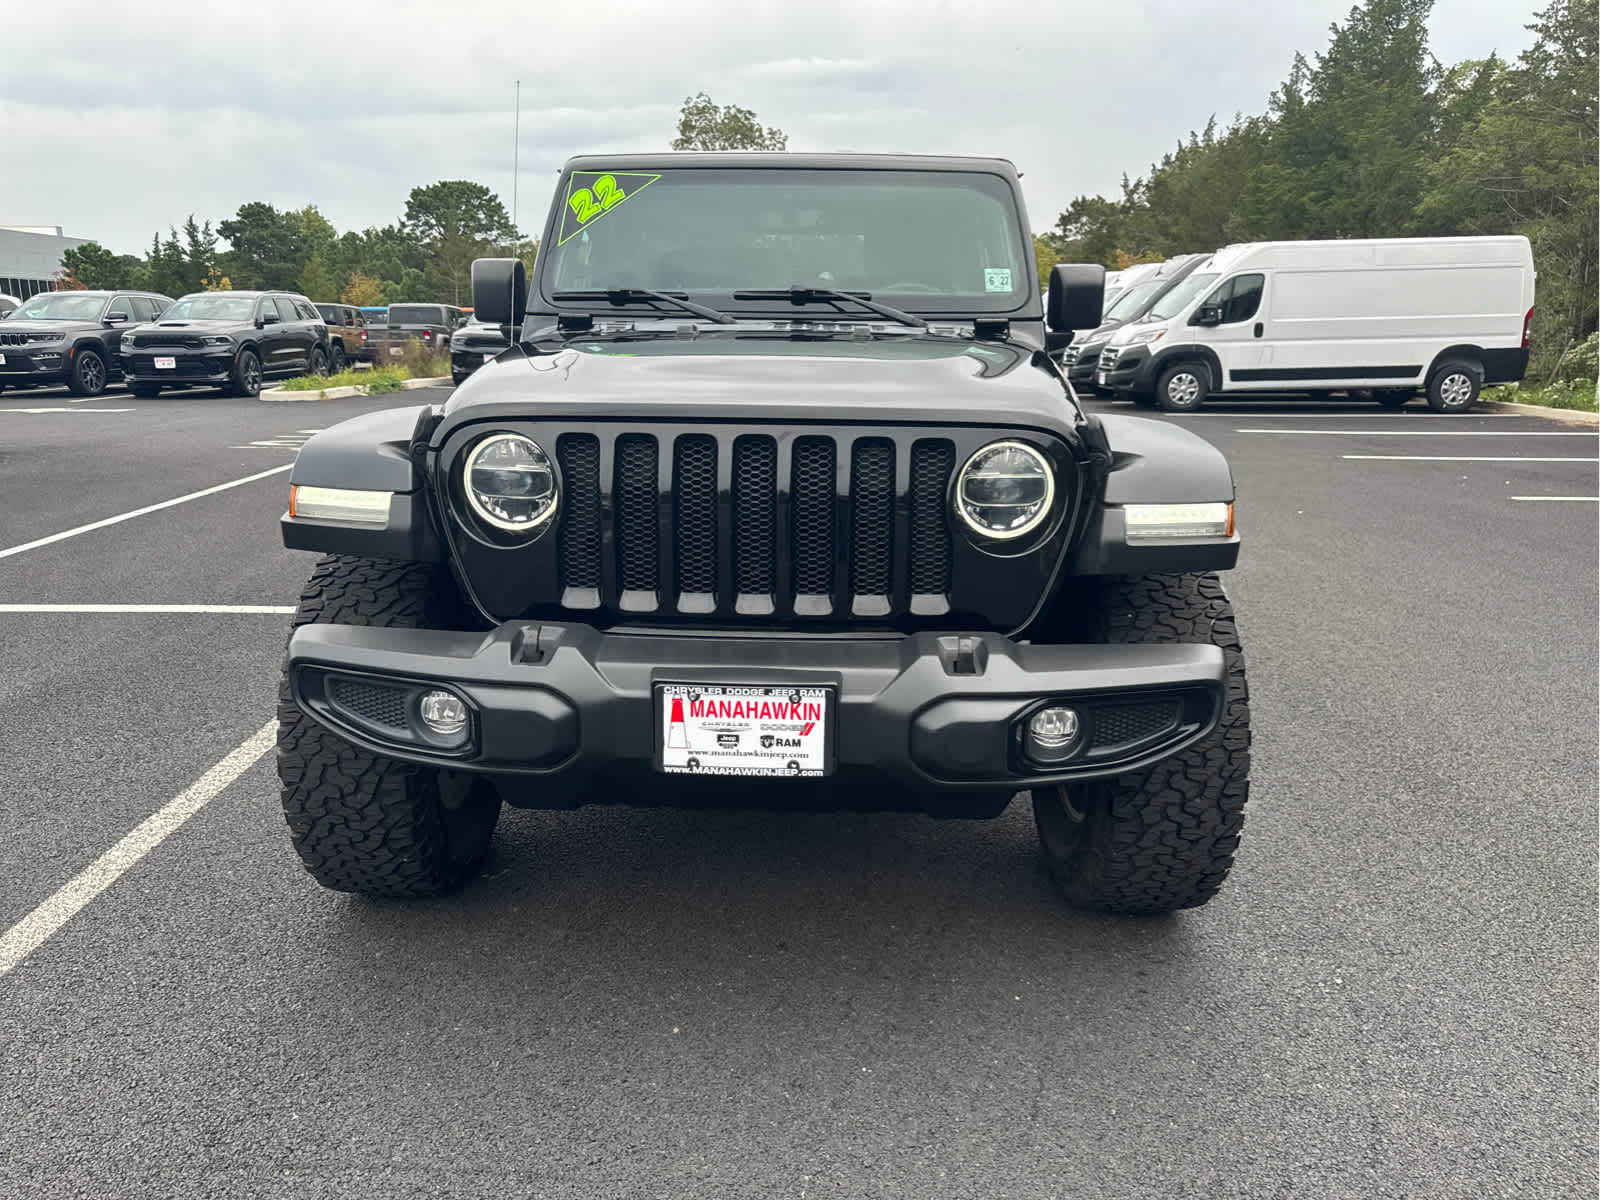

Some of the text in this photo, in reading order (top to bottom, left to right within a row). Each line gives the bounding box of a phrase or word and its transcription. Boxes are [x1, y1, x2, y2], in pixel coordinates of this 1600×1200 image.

[569, 174, 626, 225] 22
[663, 686, 826, 698] CHRYSLER DODGE JEEP RAM
[690, 699, 821, 721] MANAHAWKIN
[775, 738, 801, 748] RAM
[687, 749, 809, 760] www.manahawkinjeep.com
[663, 766, 824, 777] www.MANAHAWKINJEEP.com
